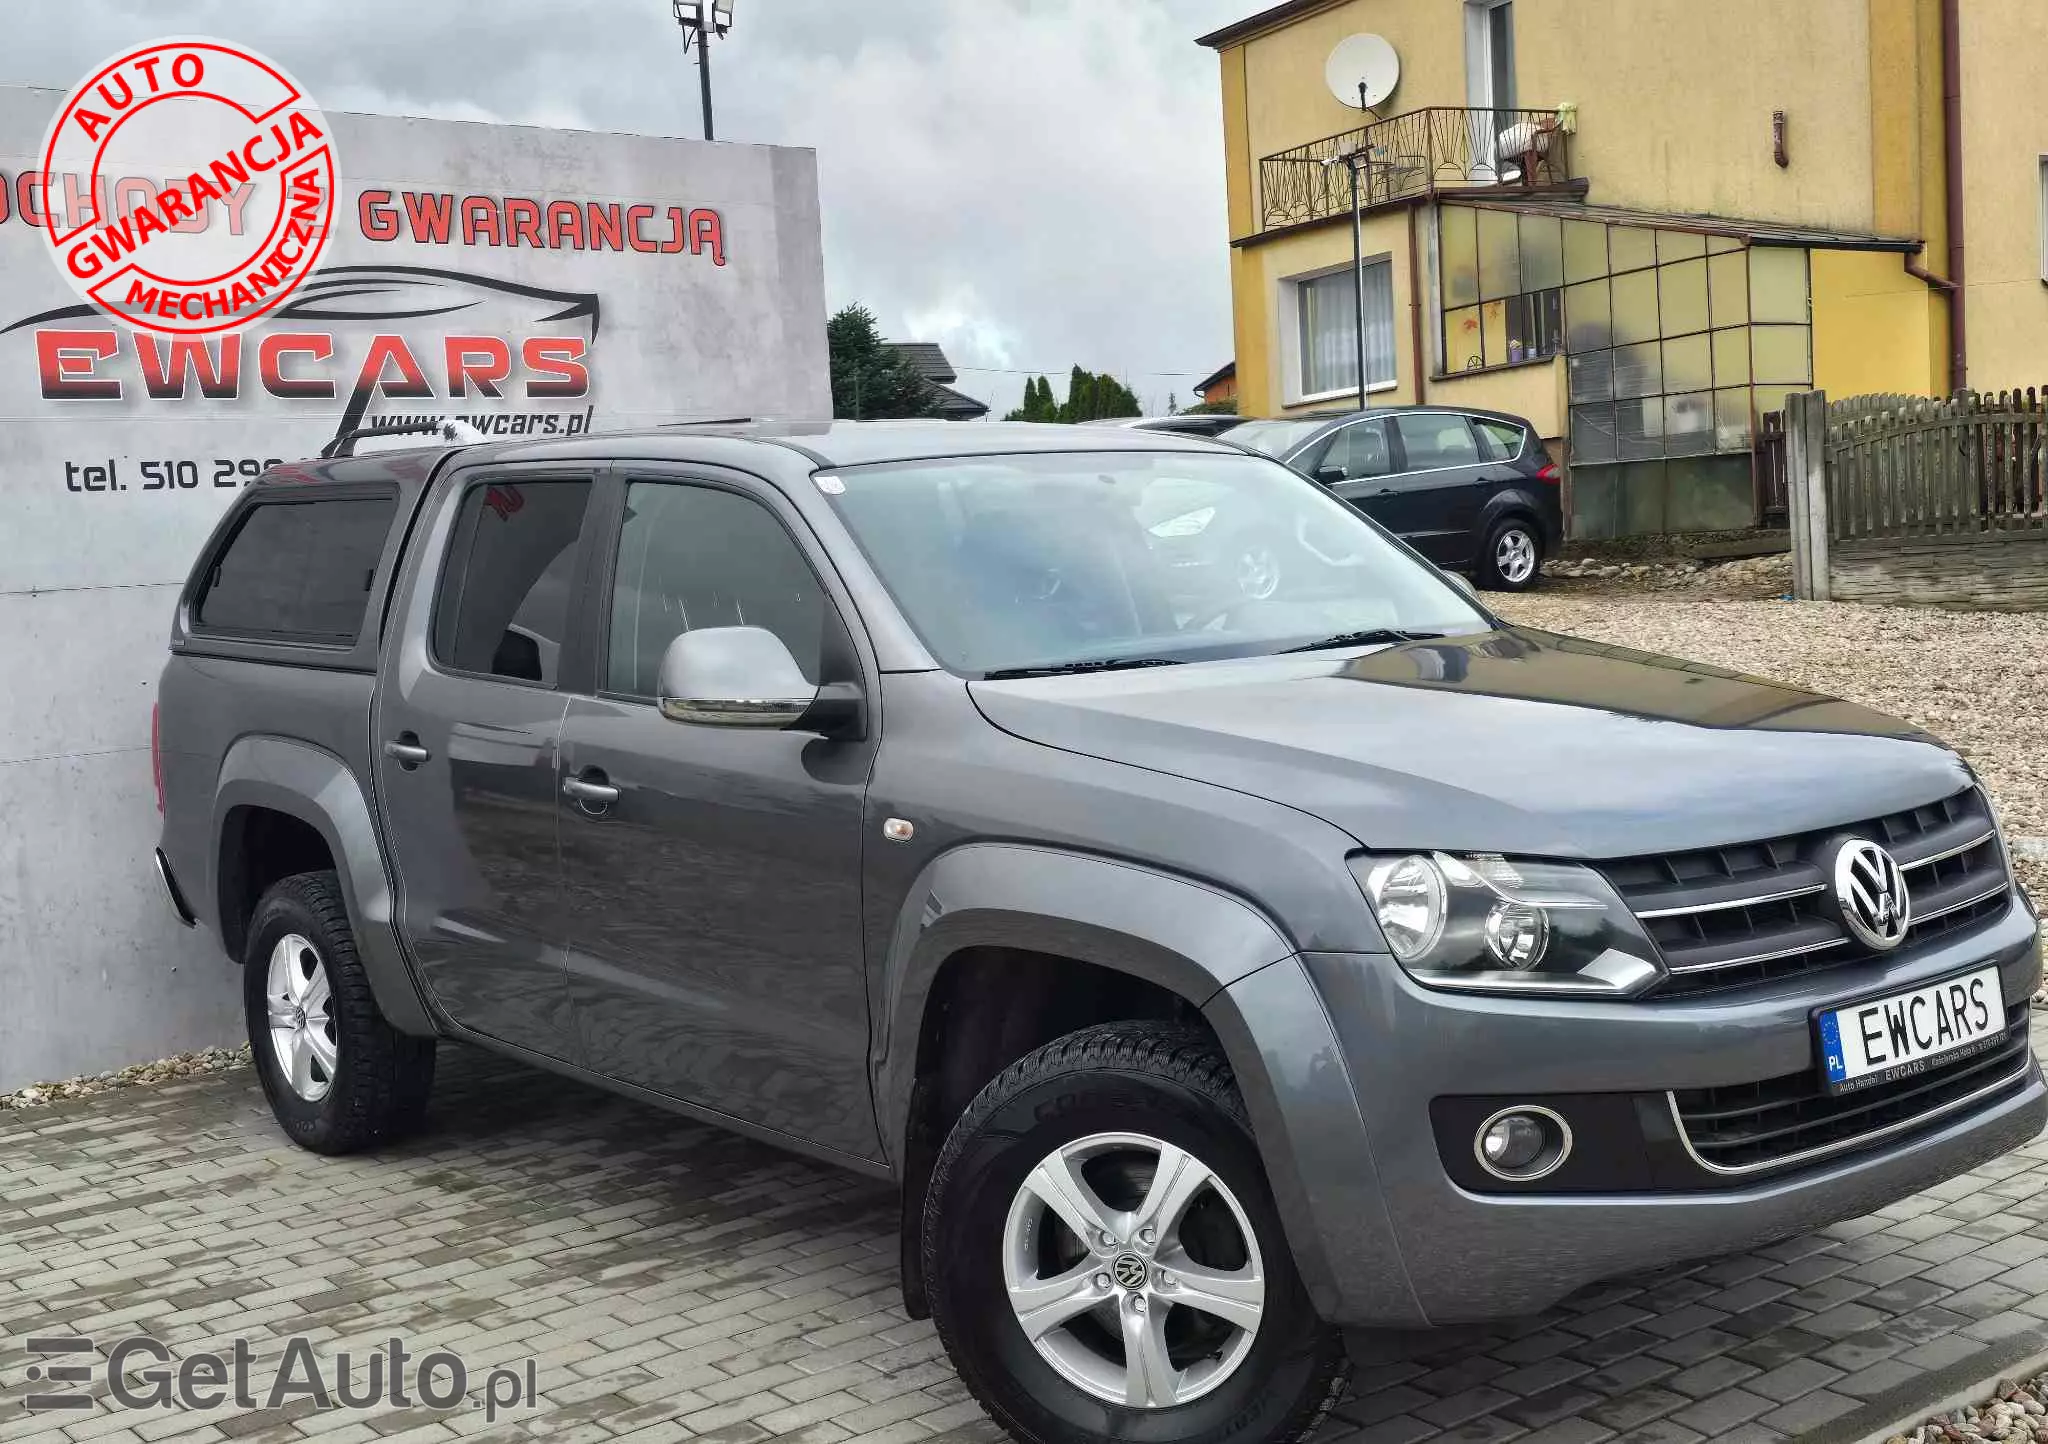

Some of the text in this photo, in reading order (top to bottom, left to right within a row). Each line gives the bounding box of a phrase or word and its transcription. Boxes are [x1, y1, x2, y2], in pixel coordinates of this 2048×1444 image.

[0, 171, 257, 236] CHODY
[358, 190, 726, 266] GWARANCJĄ
[35, 328, 591, 438] EWCARS
[64, 459, 128, 492] tel.
[140, 460, 200, 490] 510
[1858, 977, 1989, 1067] EWCARS
[1828, 1056, 1843, 1072] PL
[1885, 1060, 1925, 1082] EWCARS
